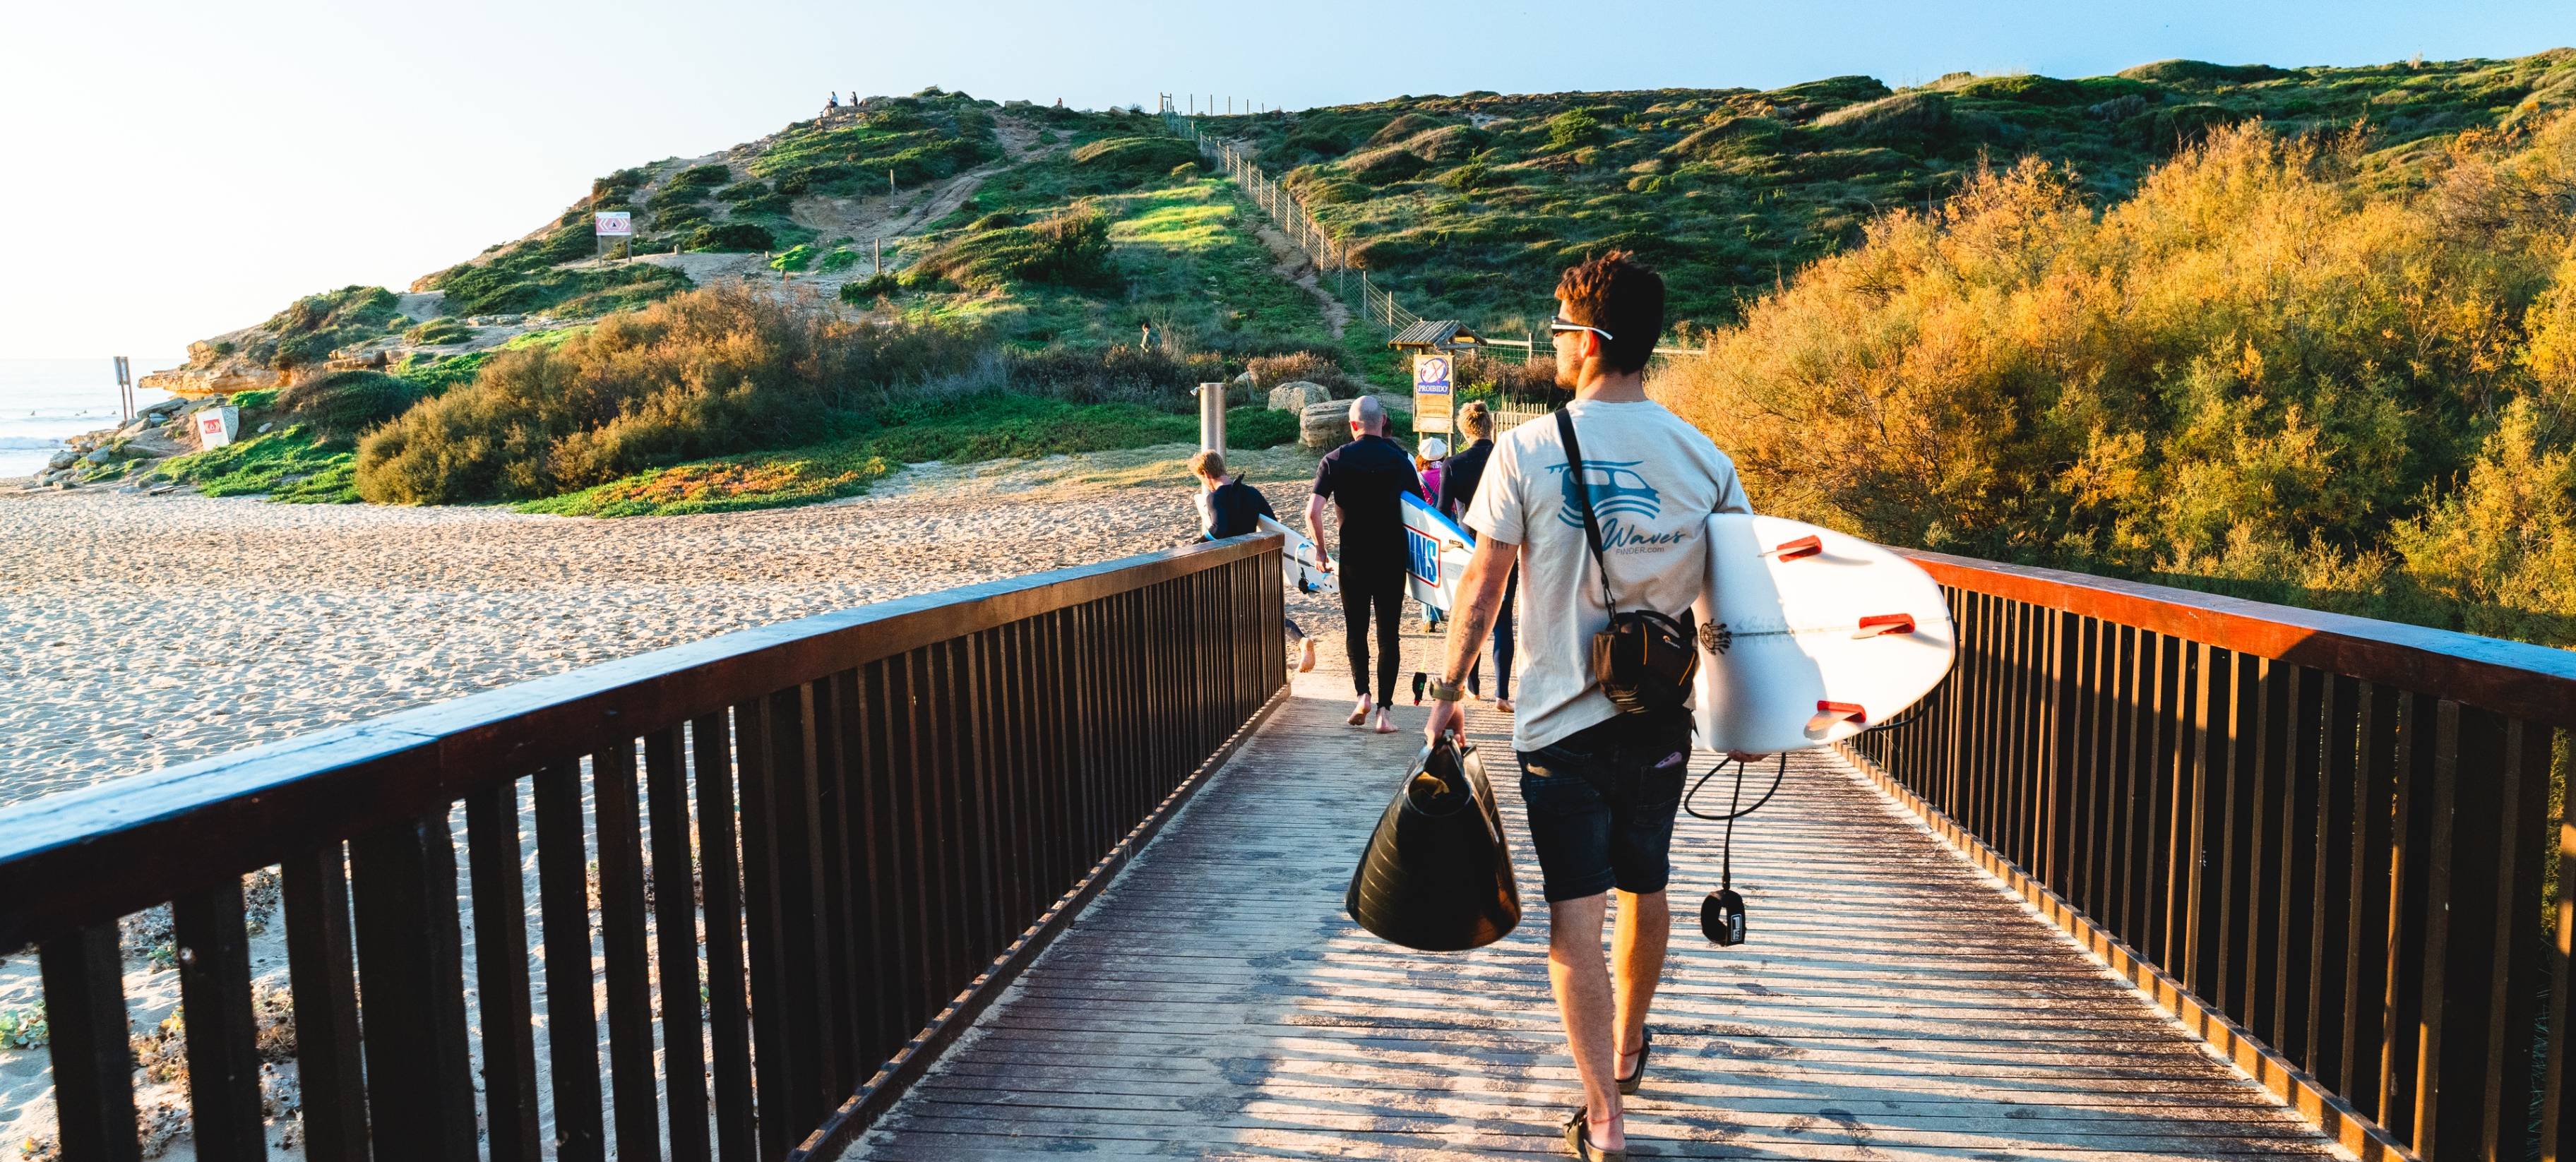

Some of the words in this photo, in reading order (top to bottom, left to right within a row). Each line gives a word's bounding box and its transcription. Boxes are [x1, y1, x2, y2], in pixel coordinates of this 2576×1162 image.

[1602, 517, 1686, 552] Waves
[1616, 546, 1664, 556] FINDER.com
[1404, 527, 1436, 583] INS
